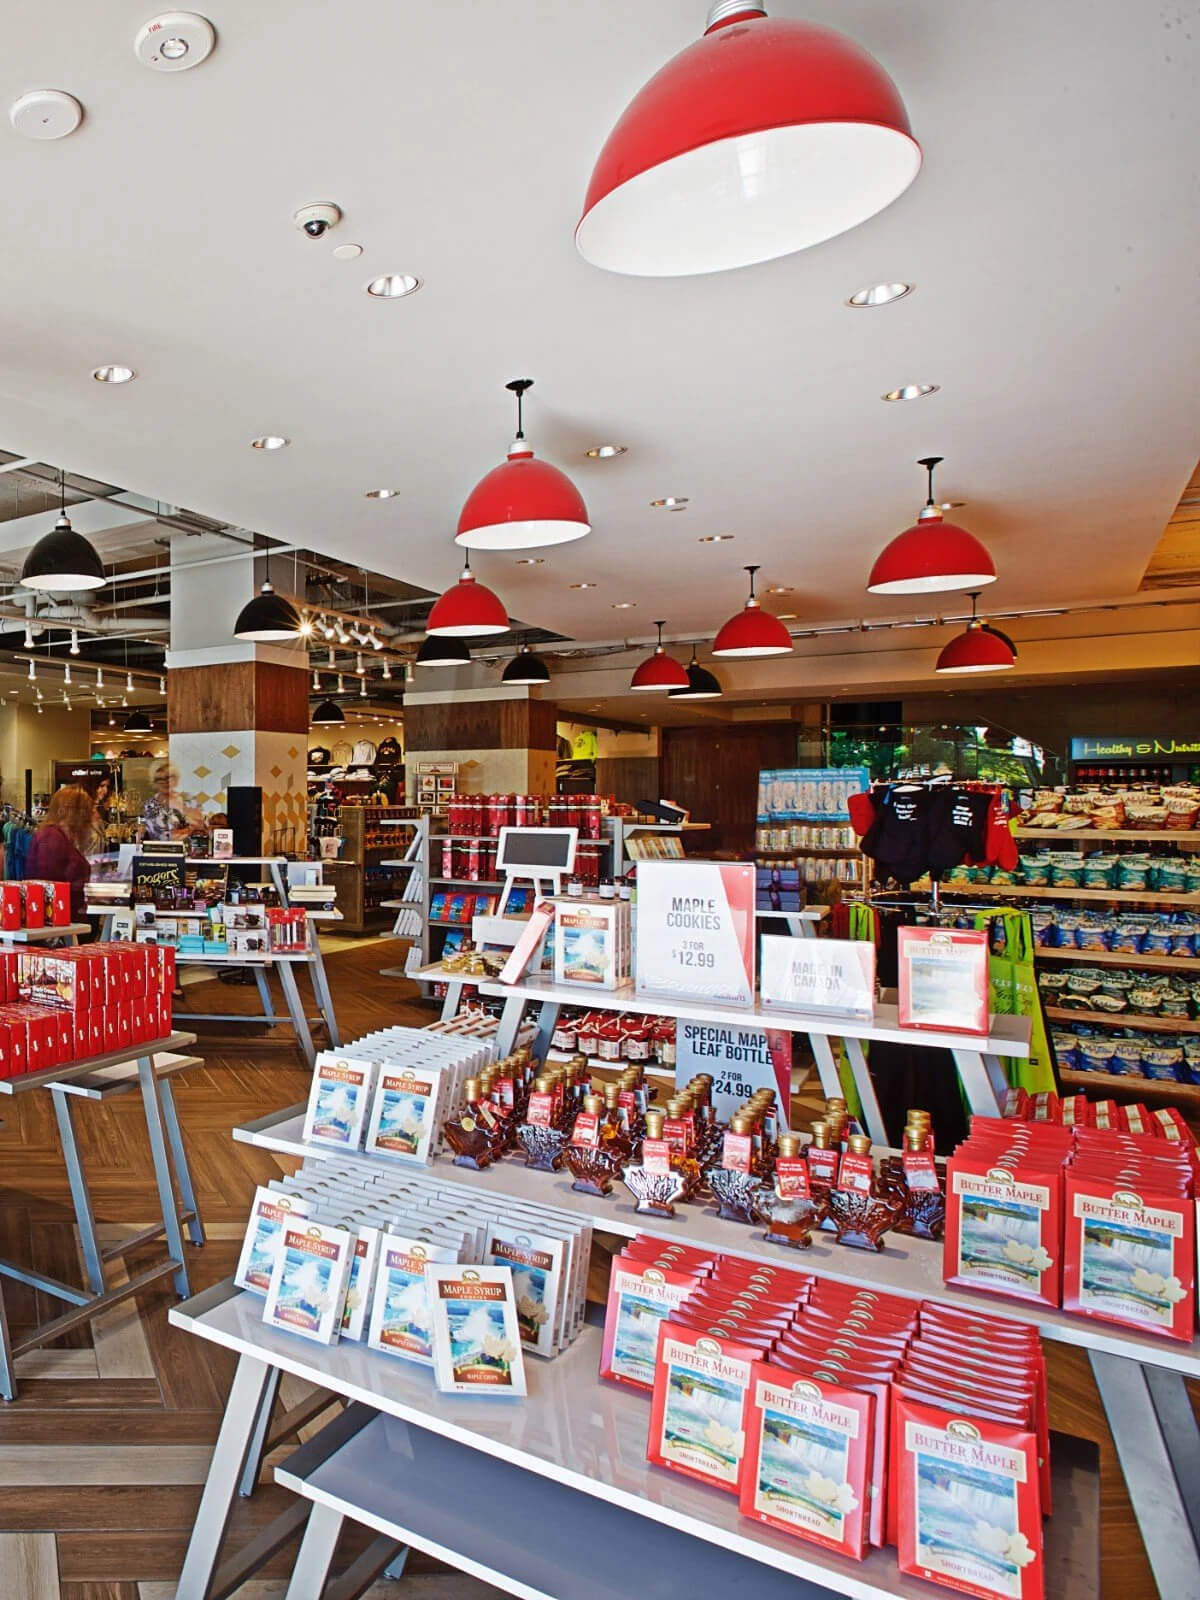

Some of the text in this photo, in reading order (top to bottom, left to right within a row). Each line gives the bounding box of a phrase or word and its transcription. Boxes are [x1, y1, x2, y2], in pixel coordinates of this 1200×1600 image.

[1084, 742, 1132, 757] Healthy
[672, 897, 715, 914] MAPLE
[667, 913, 721, 930] COOKIES
[689, 941, 704, 950] FOR
[672, 949, 715, 968] $12.99
[830, 964, 843, 978] IN
[685, 1025, 783, 1051] SPECIAL MAPLE
[692, 1041, 773, 1065] LEAF BOTTLE
[321, 1068, 340, 1079] MAPLE
[721, 1071, 742, 1082] 2 FOR
[386, 1079, 406, 1089] MAPLE
[960, 1178, 1042, 1203] BUTTER MAPLE
[1082, 1202, 1176, 1230] BUTTER MAPLE
[288, 1235, 336, 1255] MAPLE SYRUP
[495, 1243, 521, 1257] MAPLE
[391, 1255, 417, 1268] MAPLE
[443, 1285, 502, 1296] MAPLE SYRUP
[623, 1279, 654, 1296] BUTTER
[670, 1347, 746, 1379] BUTTER MAPLE
[763, 1389, 851, 1428] BUTTER MAPLE
[915, 1432, 1019, 1471] BUTTER MAPLE
[776, 1504, 821, 1527] SHORTBREAD
[941, 1559, 994, 1582] SHORTBREAD
